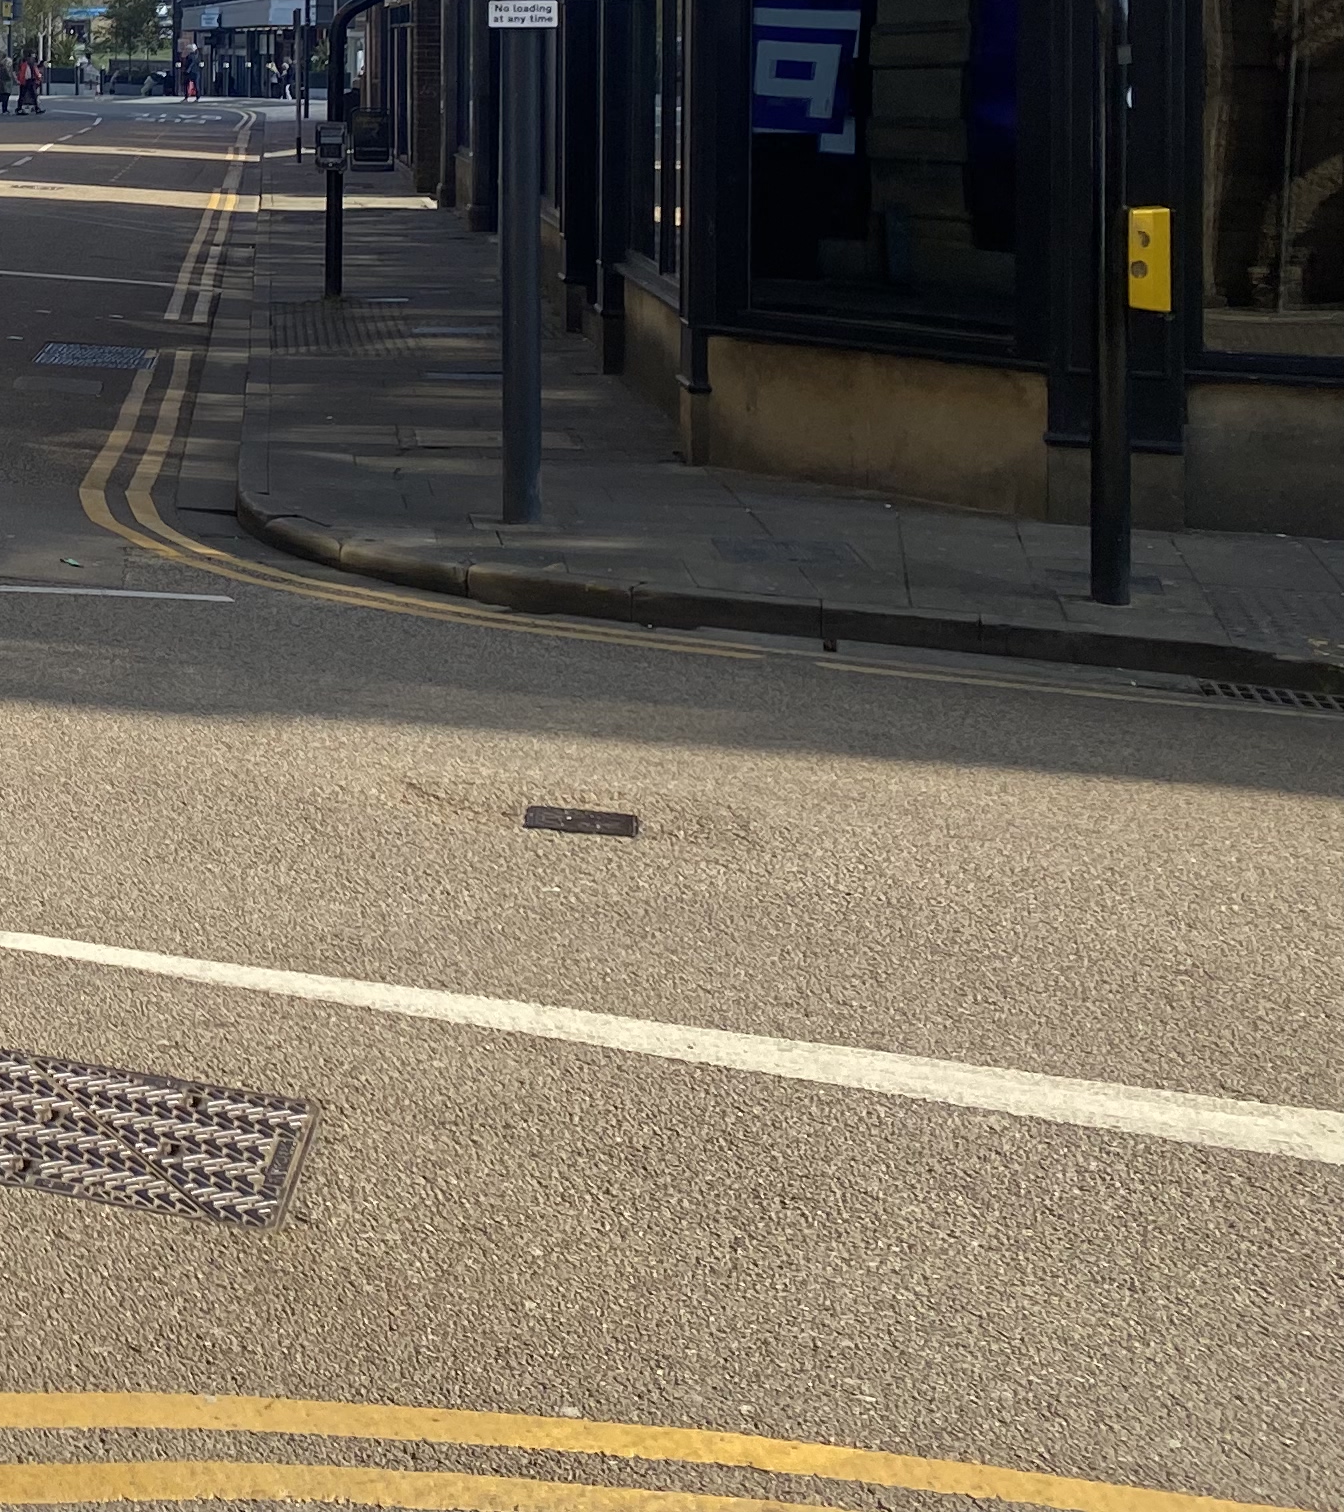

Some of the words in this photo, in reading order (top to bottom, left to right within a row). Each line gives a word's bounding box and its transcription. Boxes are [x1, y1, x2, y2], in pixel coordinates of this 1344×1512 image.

[494, 4, 510, 13] No
[512, 4, 553, 14] loading
[493, 15, 504, 23] at
[507, 16, 526, 24] any
[529, 15, 553, 23] time
